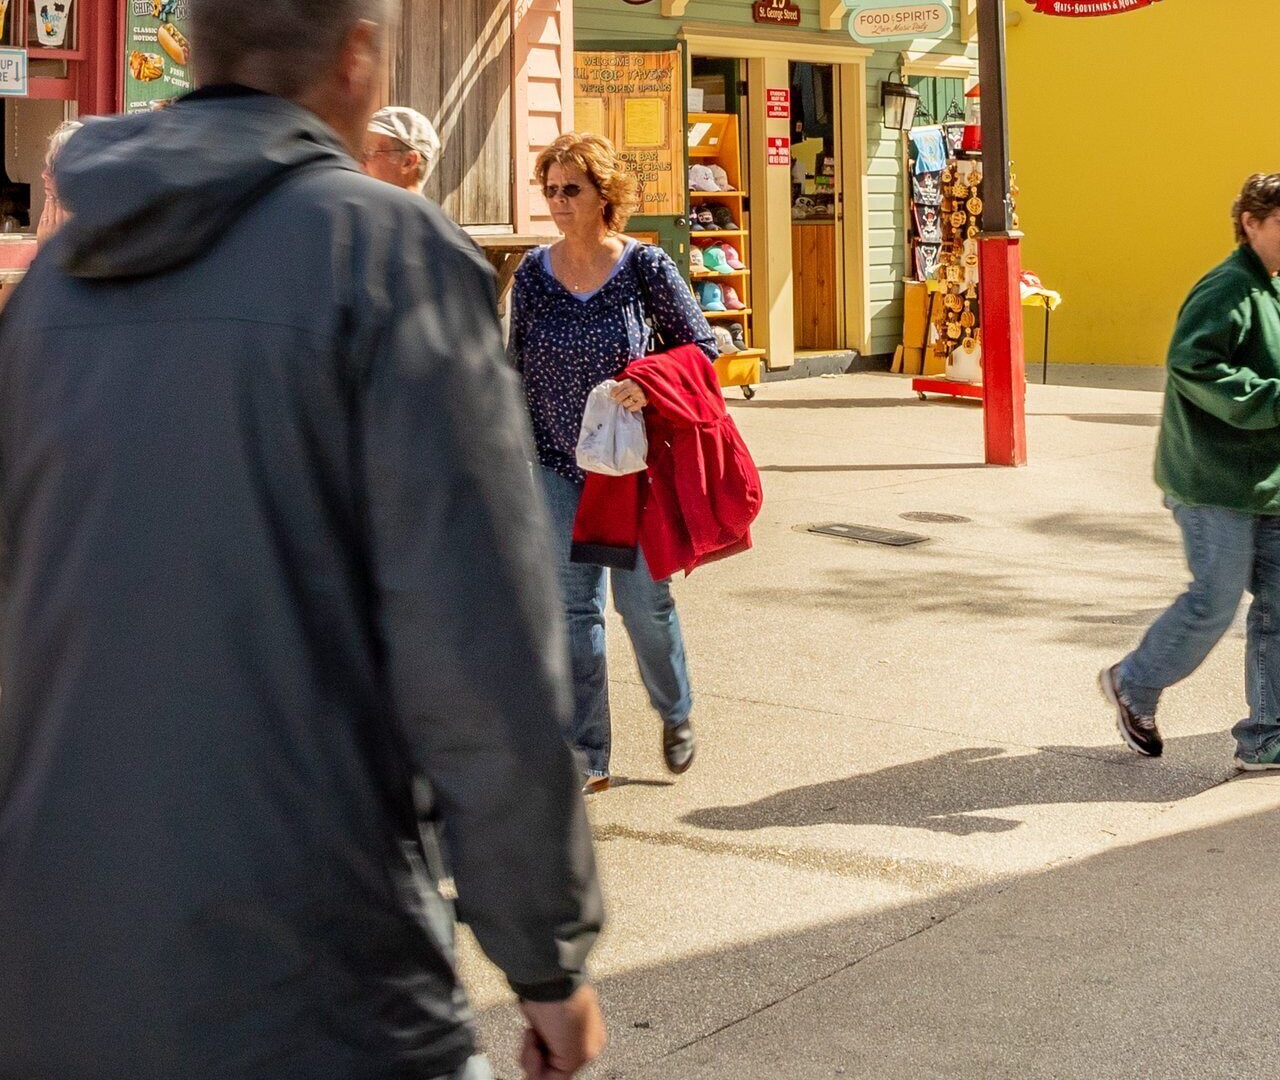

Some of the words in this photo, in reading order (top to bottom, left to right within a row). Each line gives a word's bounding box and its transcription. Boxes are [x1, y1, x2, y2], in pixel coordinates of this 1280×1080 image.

[133, 1, 154, 15] CHIPS
[1053, 1, 1071, 12] HATS
[1074, 1, 1111, 13] SOUVENIRS
[1113, 0, 1118, 9] &
[767, 7, 783, 21] George
[784, 9, 798, 20] Street
[860, 13, 890, 25] FOOD
[895, 9, 939, 24] SPIRITS
[584, 56, 629, 66] WELCOME
[170, 67, 184, 77] FISH
[171, 77, 190, 88] CHIPS
[606, 84, 635, 93] OPEN
[638, 152, 658, 161] BAR
[625, 162, 672, 171] SPECIALS
